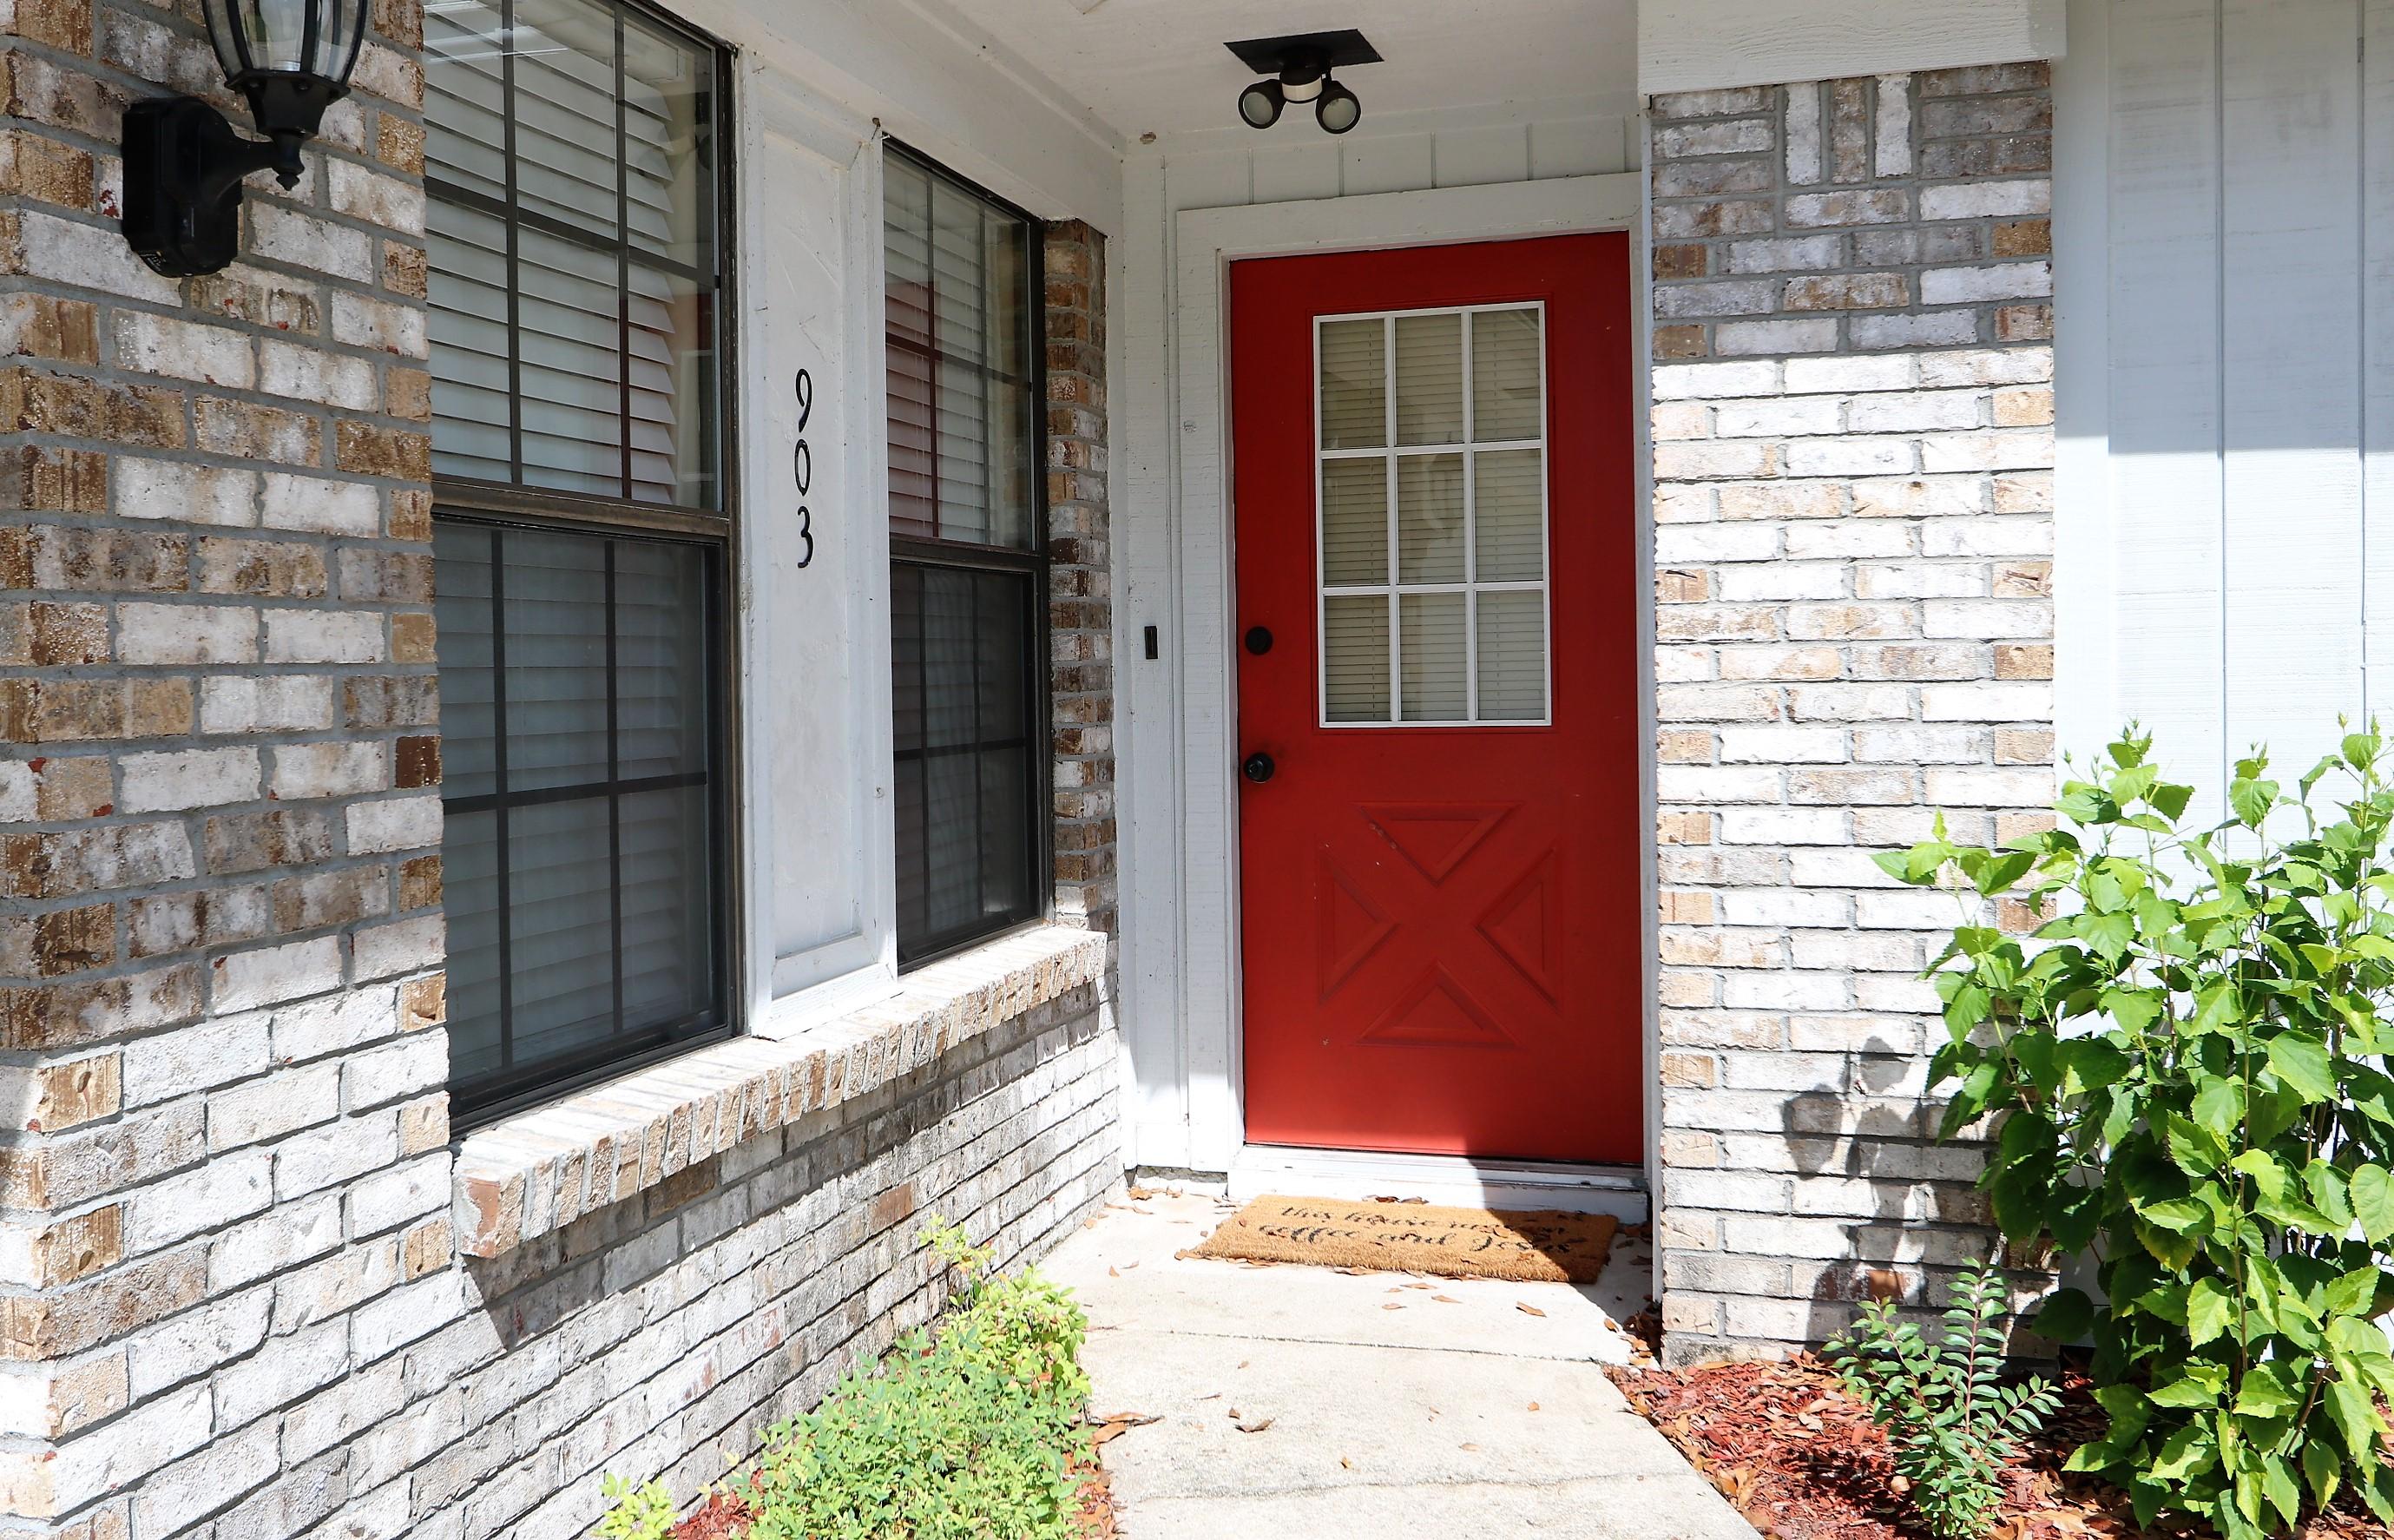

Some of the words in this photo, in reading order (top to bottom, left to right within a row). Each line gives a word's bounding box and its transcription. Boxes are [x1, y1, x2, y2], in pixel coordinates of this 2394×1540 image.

[793, 368, 814, 569] 903
[1280, 1207, 1332, 1221] this
[1344, 1212, 1437, 1227] house
[1258, 1225, 1359, 1245] coffee
[1377, 1229, 1457, 1246] and
